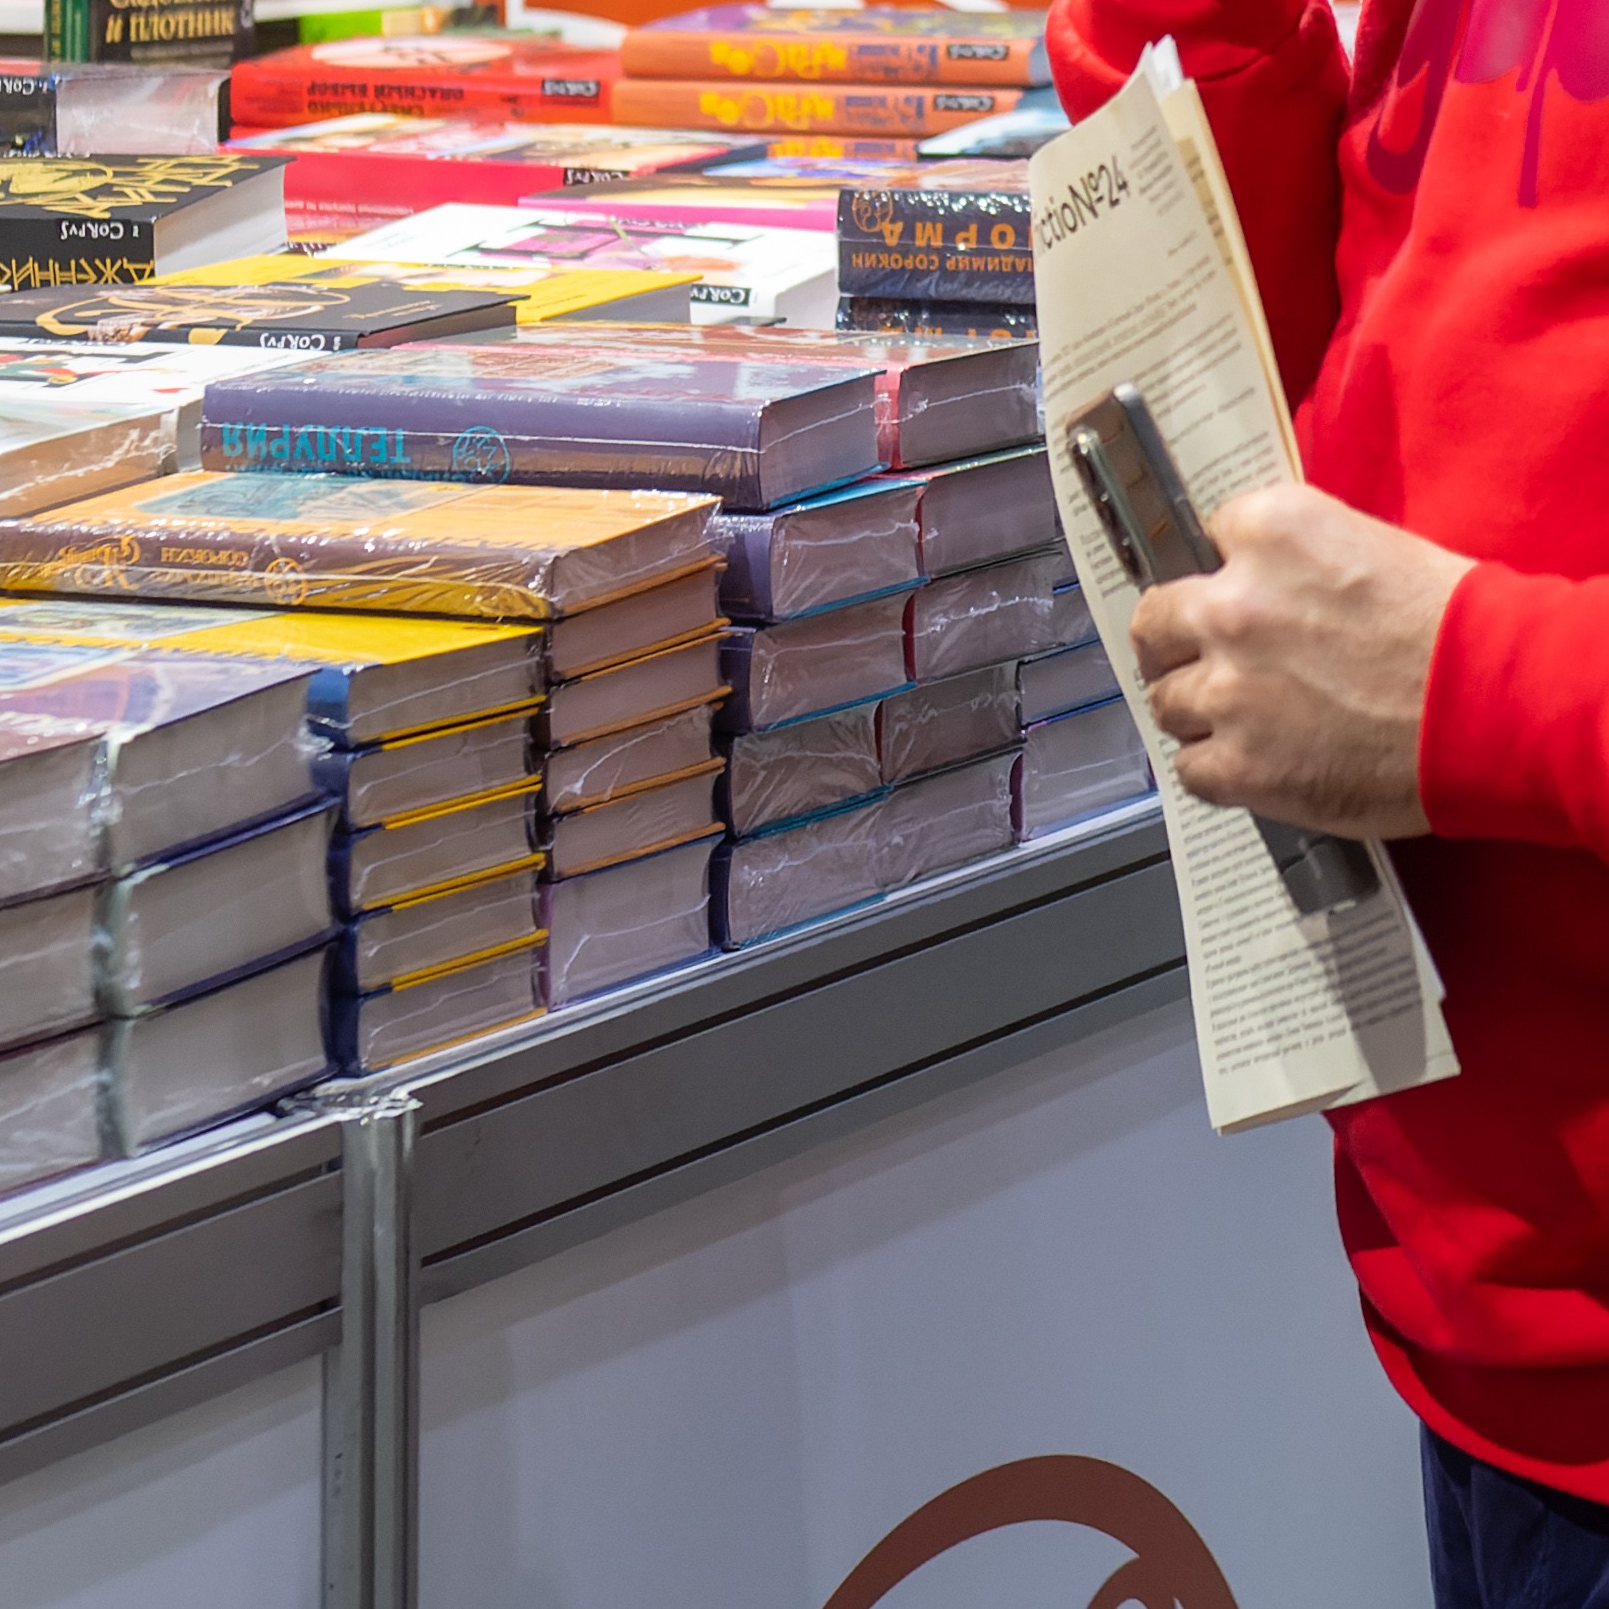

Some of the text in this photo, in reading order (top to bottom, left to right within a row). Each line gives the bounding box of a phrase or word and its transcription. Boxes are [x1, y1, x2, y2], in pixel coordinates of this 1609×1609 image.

[105, 6, 236, 44] и плотник
[881, 220, 1031, 249] ОРМА
[851, 253, 939, 272] СОРОКИН
